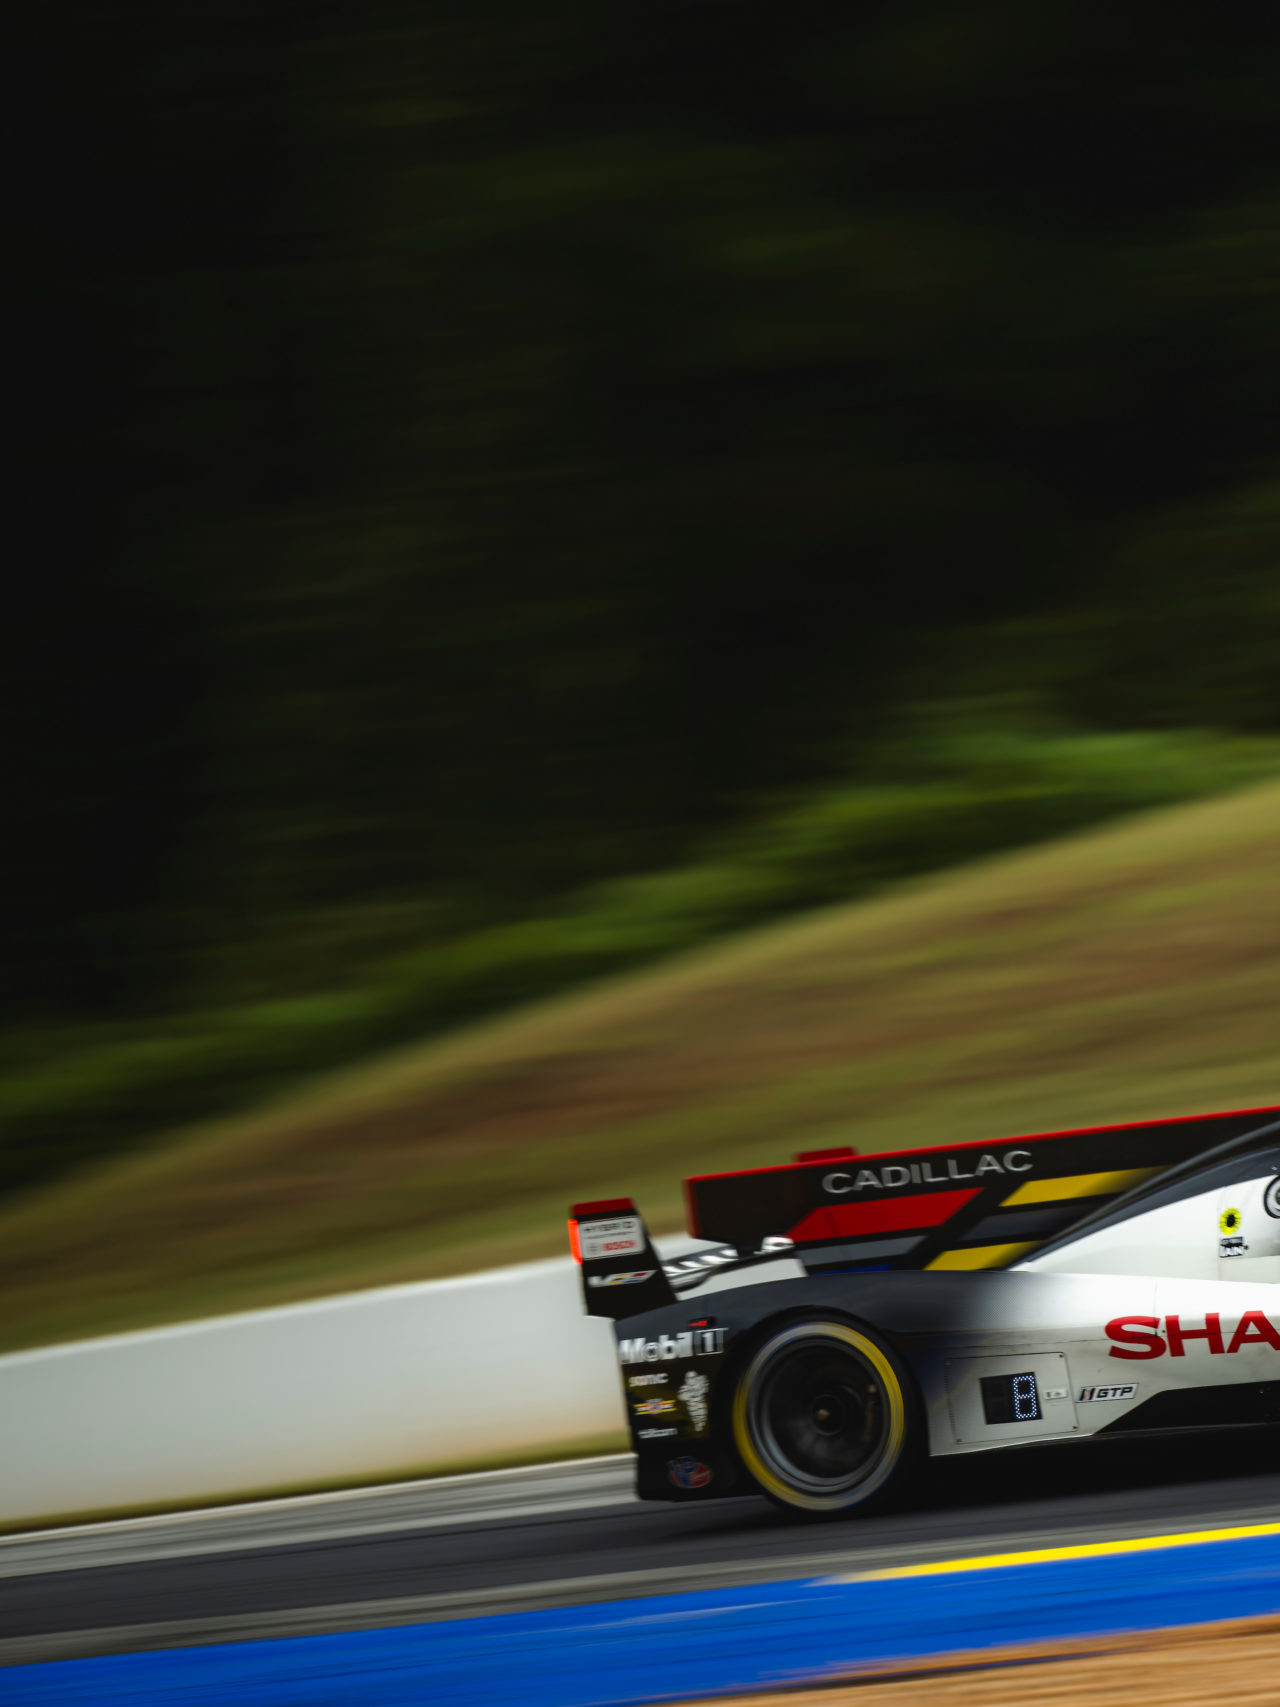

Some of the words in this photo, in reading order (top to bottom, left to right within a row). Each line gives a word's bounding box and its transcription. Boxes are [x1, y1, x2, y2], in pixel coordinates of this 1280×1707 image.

[821, 1150, 1033, 1193] CADILLAC
[619, 1332, 693, 1365] Mobil
[1013, 1375, 1037, 1419] 8
[1096, 1386, 1133, 1399] GTP
